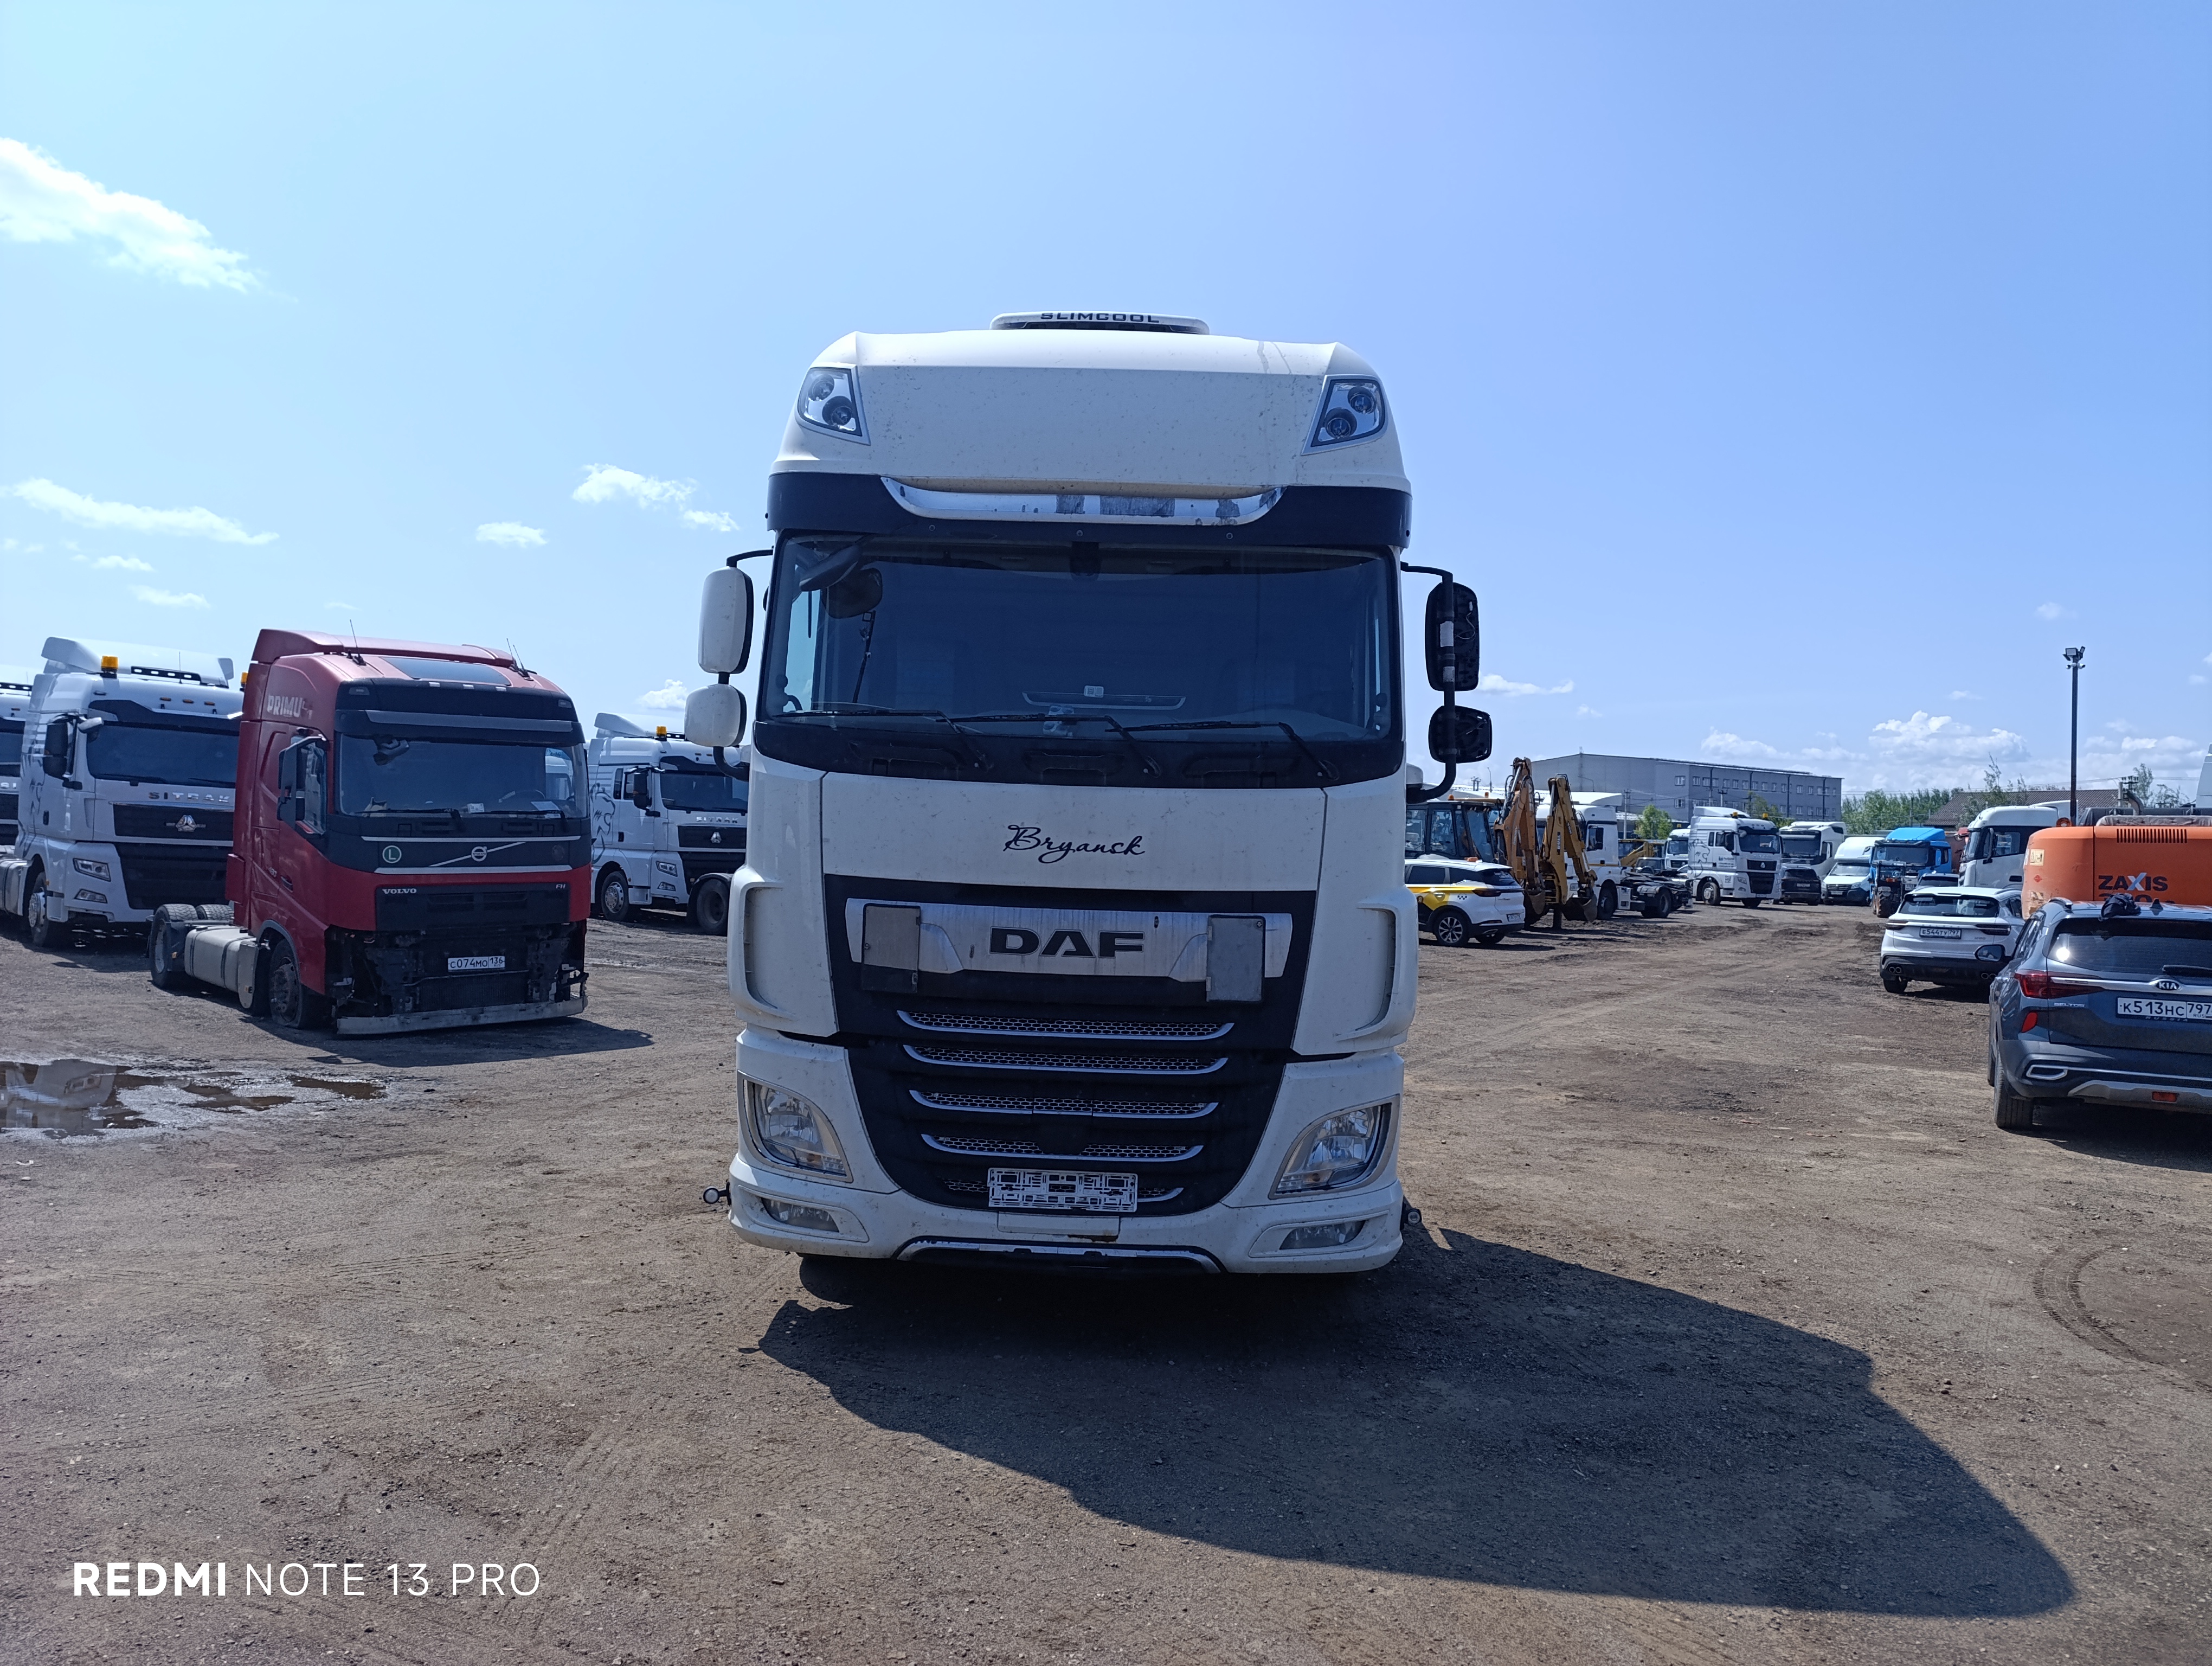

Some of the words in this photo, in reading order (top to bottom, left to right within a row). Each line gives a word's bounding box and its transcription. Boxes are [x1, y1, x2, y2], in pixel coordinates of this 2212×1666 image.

[1040, 312, 1160, 323] SLIMCOOL
[148, 791, 230, 803] SITRAK
[1002, 824, 1145, 864] Bryansk
[388, 848, 397, 860] L
[2098, 872, 2168, 892] ZAXIS
[989, 926, 1145, 958] DAF
[490, 957, 503, 965] 136
[2158, 981, 2177, 990] KIA
[2187, 1003, 2211, 1014] 797
